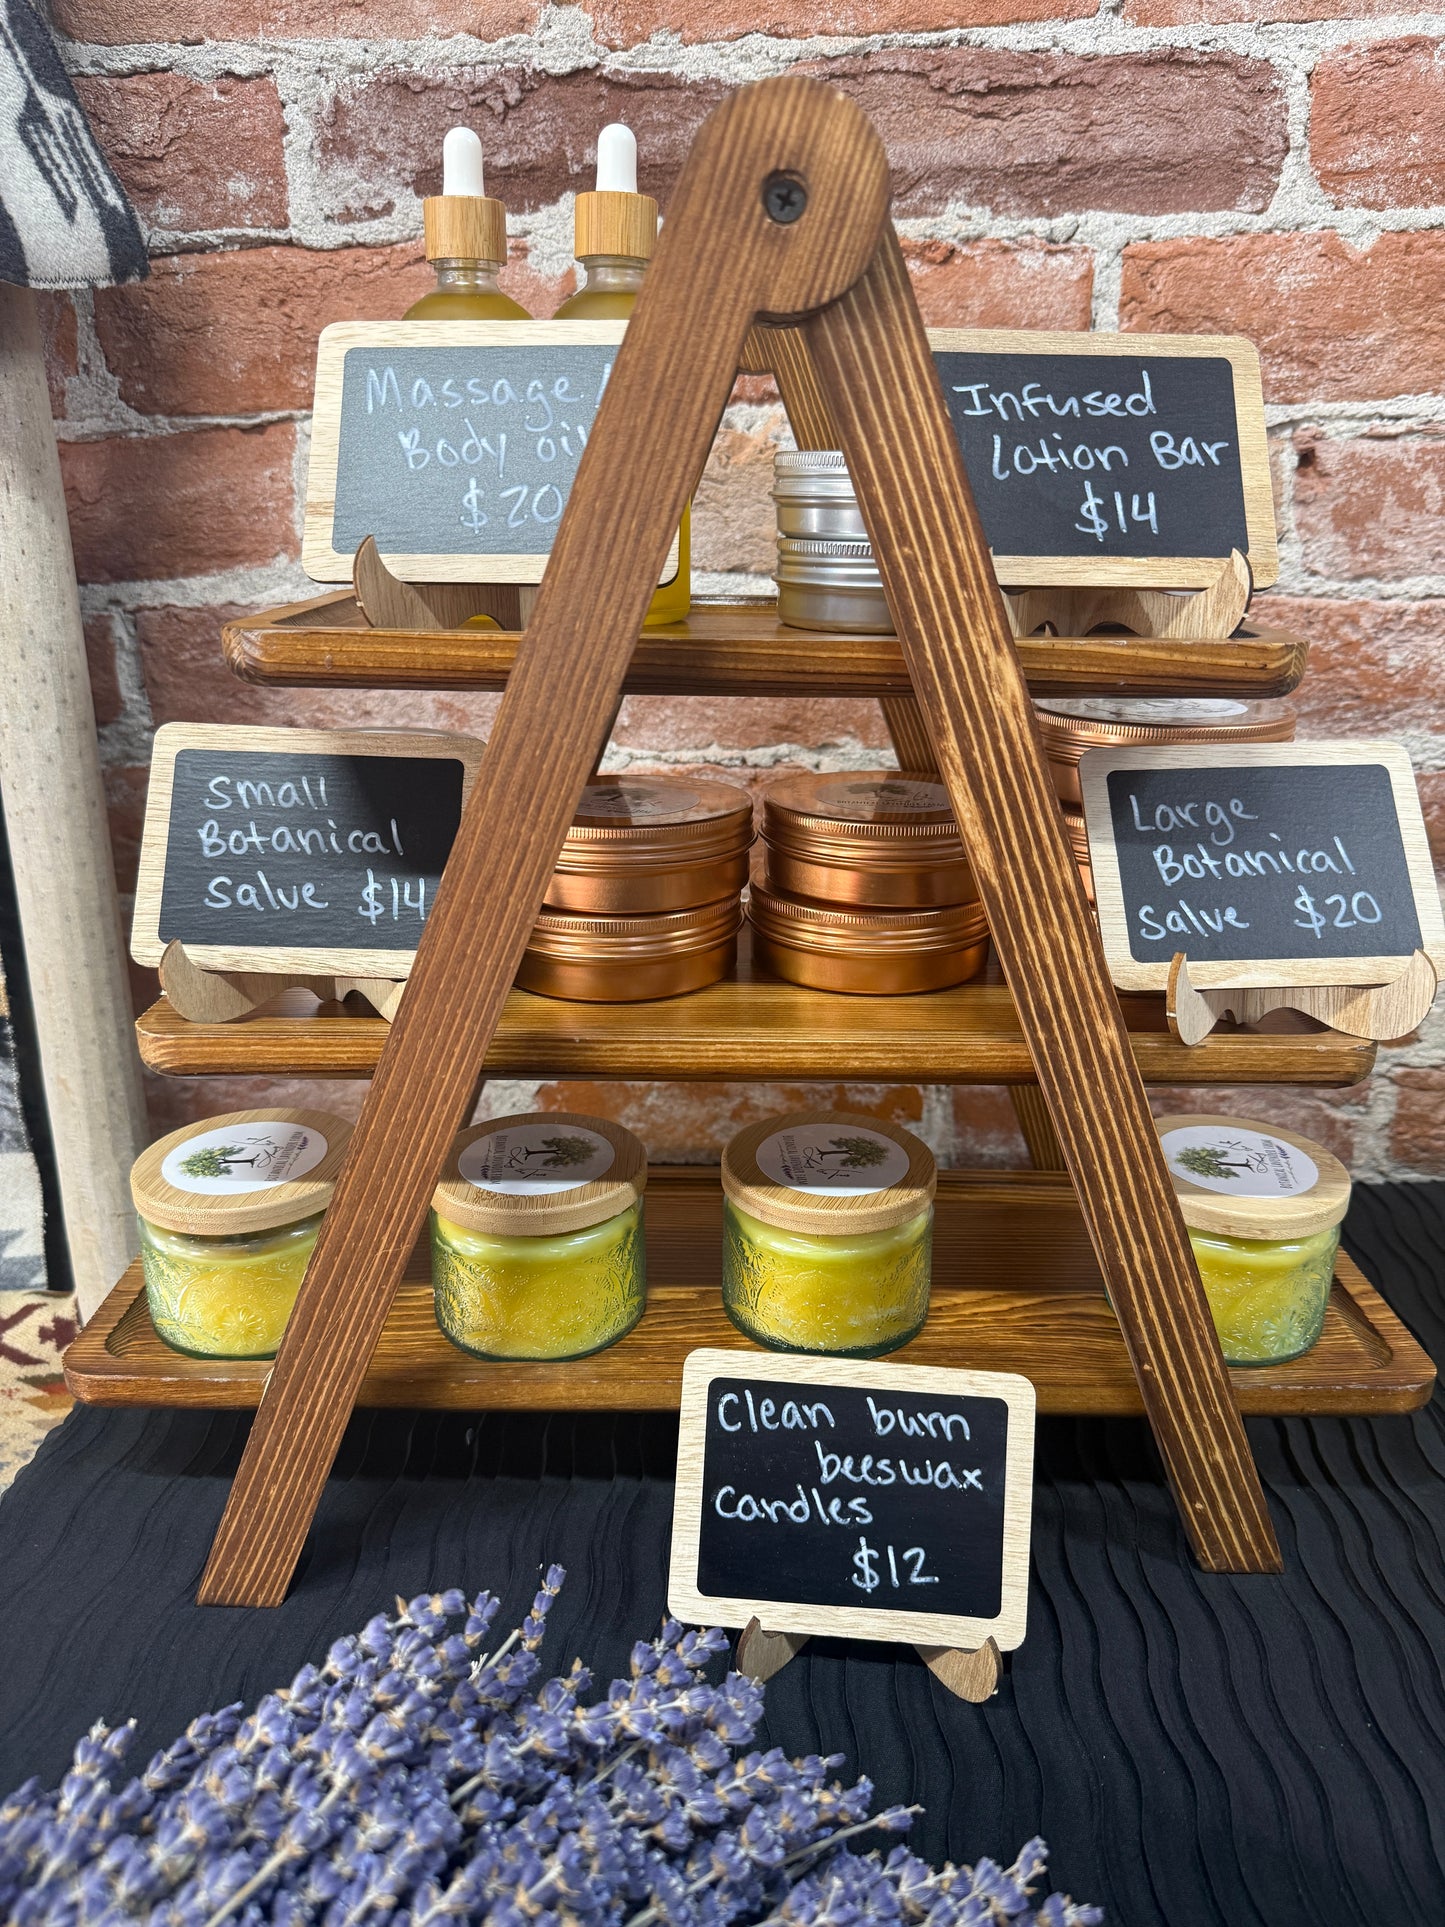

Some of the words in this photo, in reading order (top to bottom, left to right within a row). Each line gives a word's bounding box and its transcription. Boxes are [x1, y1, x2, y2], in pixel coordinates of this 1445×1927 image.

[367, 366, 585, 432] Massage
[952, 370, 1157, 421] Infused
[399, 417, 507, 478] Body
[1150, 430, 1229, 470] Bar
[460, 477, 563, 534] $20
[1075, 481, 1159, 541] $14
[198, 818, 404, 858] Botanical
[1129, 795, 1259, 847] Large
[1152, 832, 1357, 886] Botanical
[358, 868, 426, 925] $14
[1294, 885, 1383, 939] $20
[866, 1397, 971, 1441] burn
[814, 1440, 984, 1491] beeswax
[851, 1536, 940, 1593] $12
